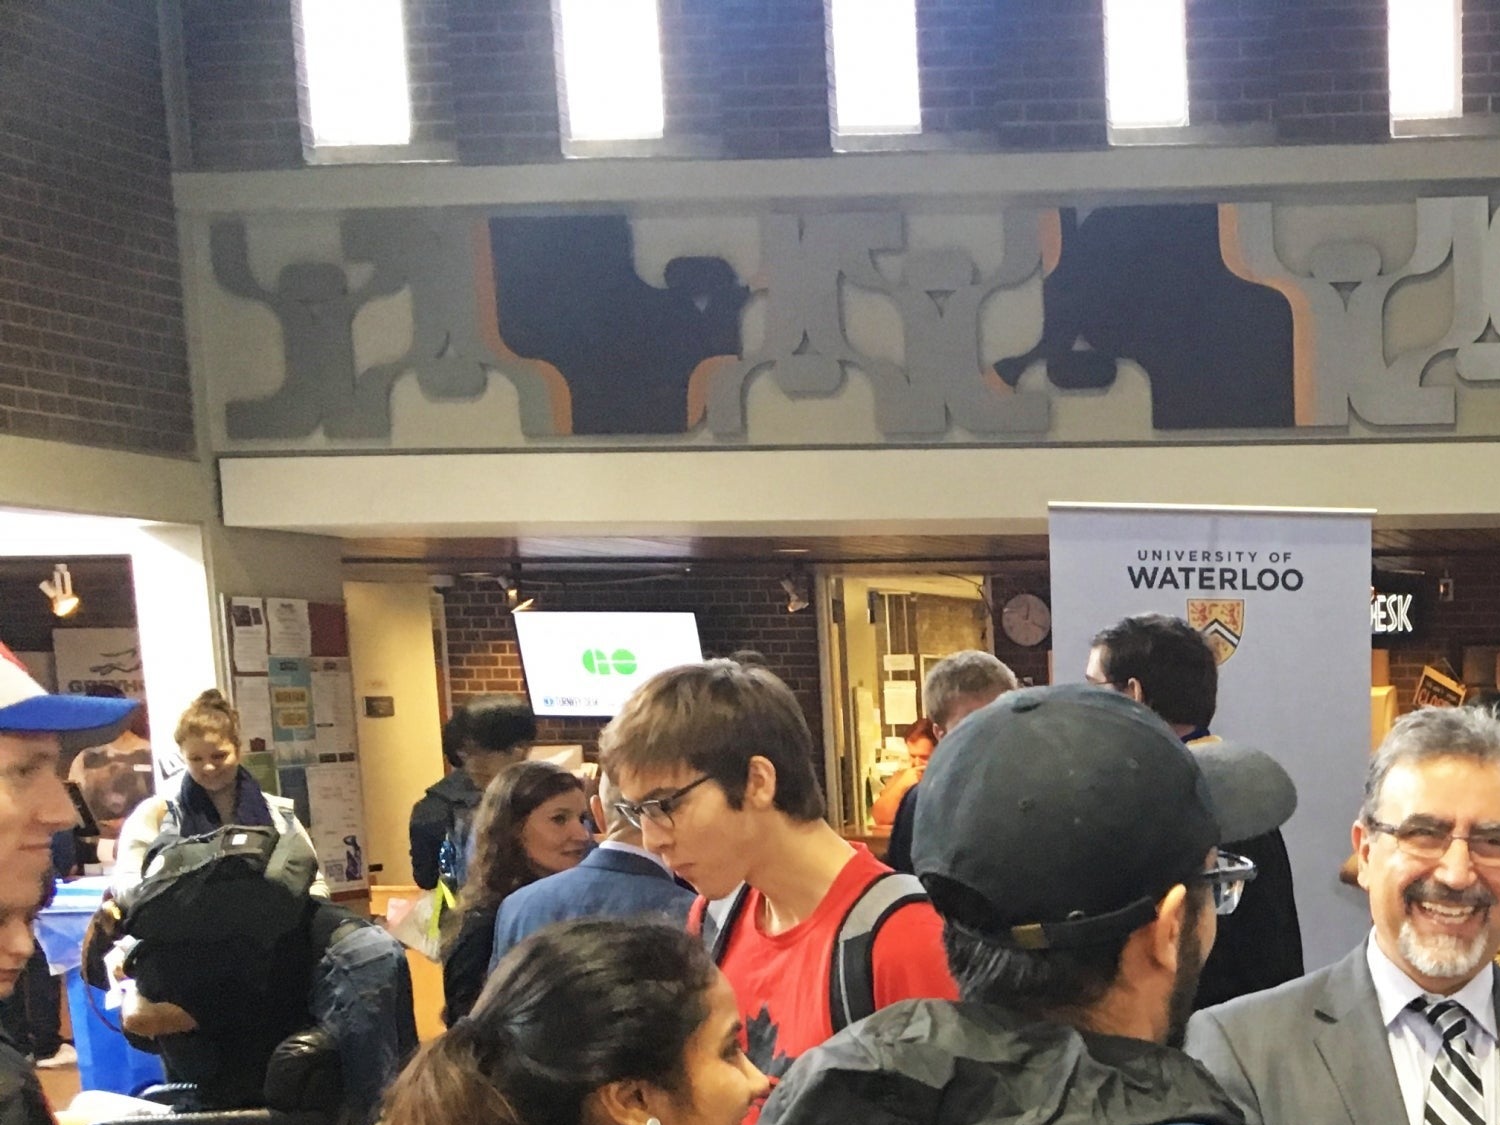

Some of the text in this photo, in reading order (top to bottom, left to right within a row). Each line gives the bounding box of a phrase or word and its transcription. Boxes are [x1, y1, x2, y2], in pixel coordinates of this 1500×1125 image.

[1137, 549, 1292, 564] UNIVERSITY OF
[1127, 566, 1304, 592] WATERLOO
[1370, 593, 1414, 633] ESK
[582, 648, 639, 676] GO
